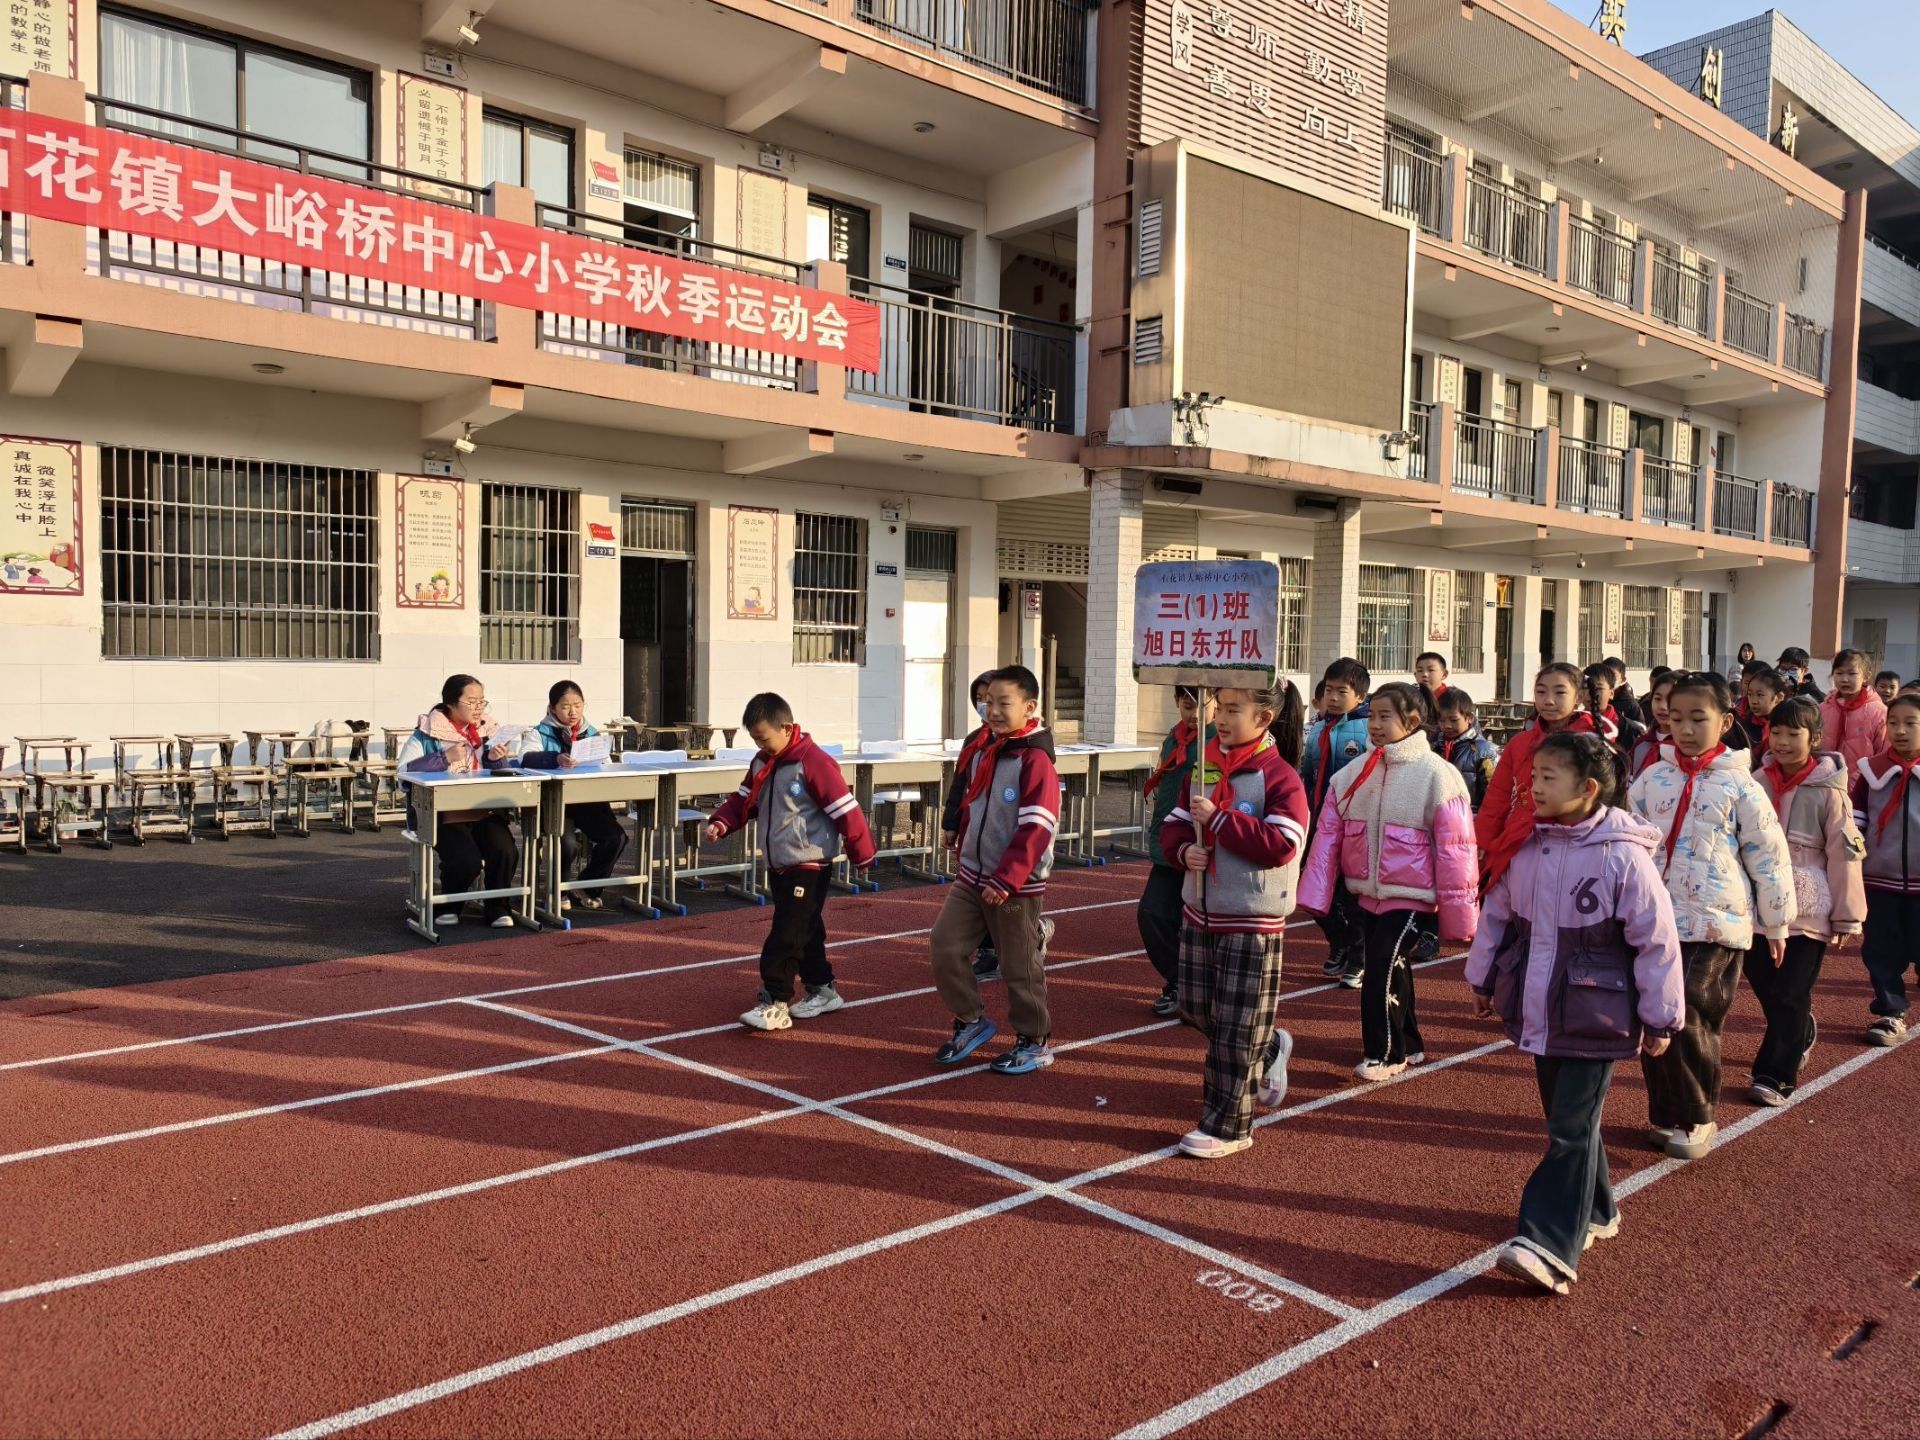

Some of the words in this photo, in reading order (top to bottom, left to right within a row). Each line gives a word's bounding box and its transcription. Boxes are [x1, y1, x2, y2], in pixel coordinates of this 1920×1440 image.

[10, 0, 28, 54] 的教学生
[1175, 12, 1190, 64] 学风
[1204, 6, 1280, 60] 尊师
[1303, 50, 1366, 98] 勤学
[1203, 64, 1275, 119] 善思
[1300, 107, 1364, 154] 向上
[0, 127, 849, 350] 花镇大峪桥中心小学秋季运动会
[13, 450, 32, 523] 真诚在我心中
[37, 465, 57, 537] 微笑浮在脸上
[1157, 591, 1250, 620] 三(1)班
[1143, 627, 1262, 660] 旭日东升队
[1576, 877, 1599, 914] 6
